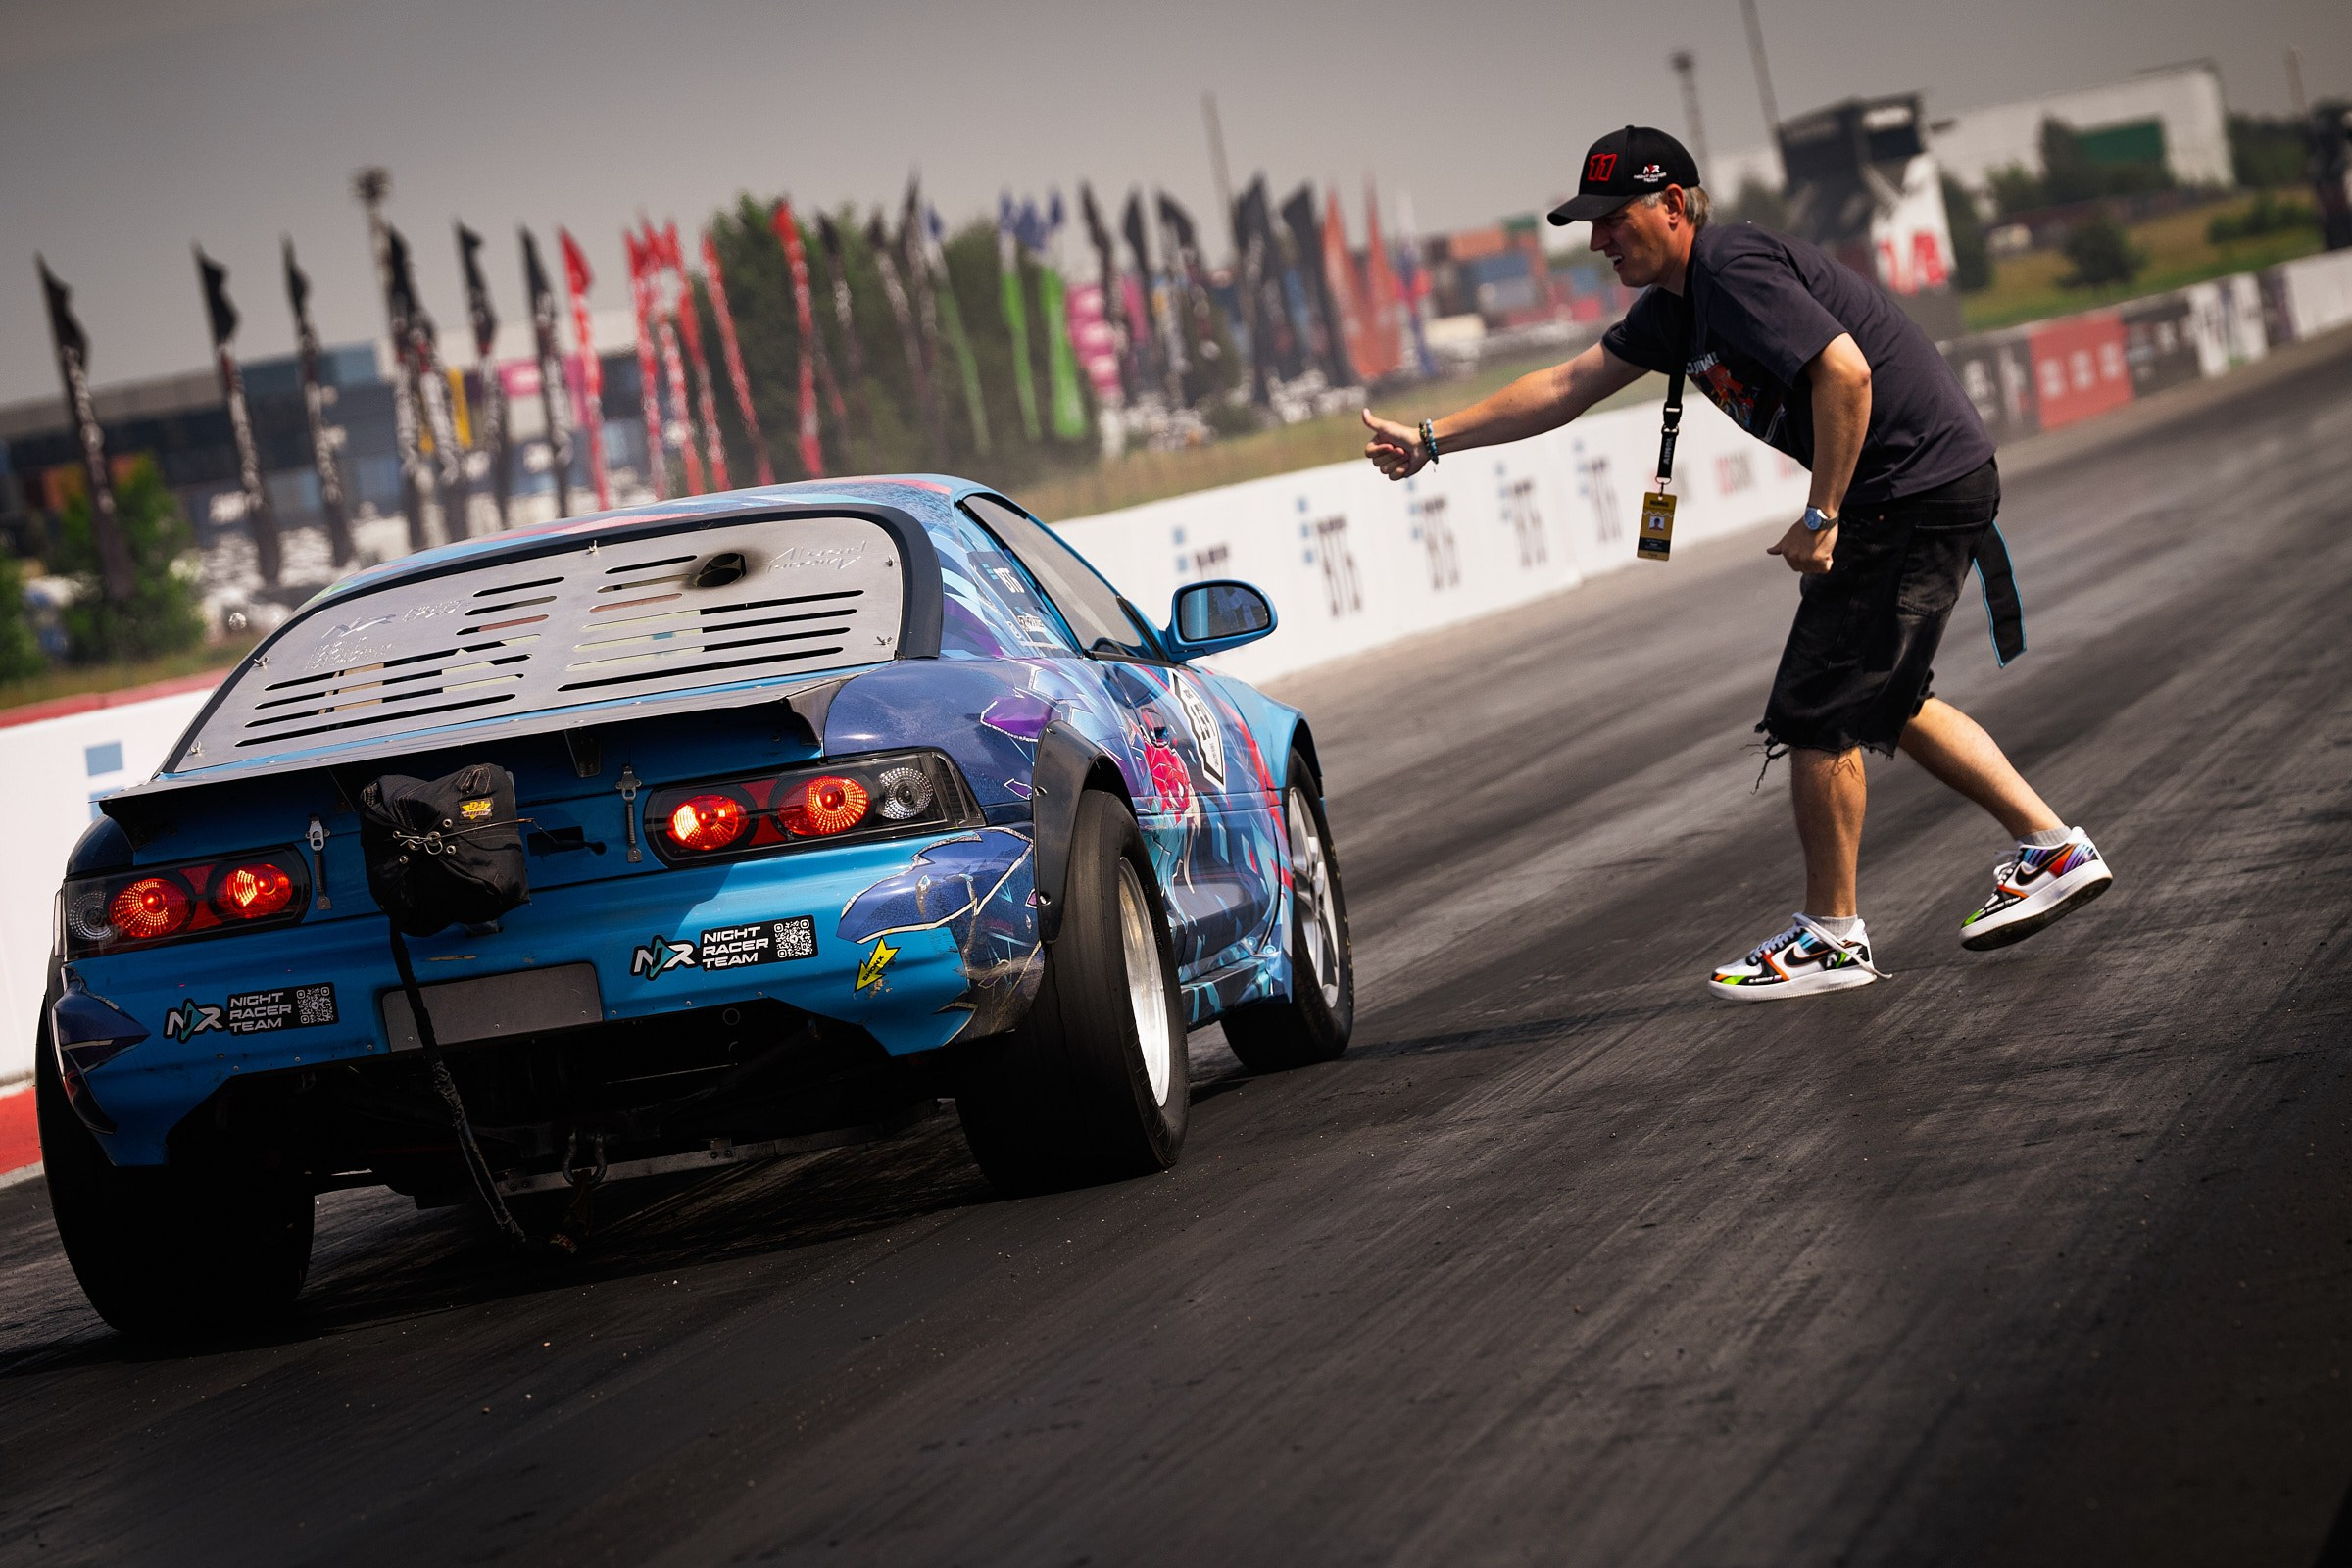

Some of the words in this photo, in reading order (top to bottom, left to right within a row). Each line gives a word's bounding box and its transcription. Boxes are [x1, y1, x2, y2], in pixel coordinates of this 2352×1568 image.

[1588, 153, 1618, 182] 11
[469, 801, 485, 809] DJ
[703, 926, 761, 944] NIGHT
[702, 937, 769, 956] RACER
[702, 952, 760, 969] TEAM
[229, 992, 284, 1008] NIGHT
[228, 1004, 292, 1021] RACER
[229, 1017, 283, 1033] TEAM
